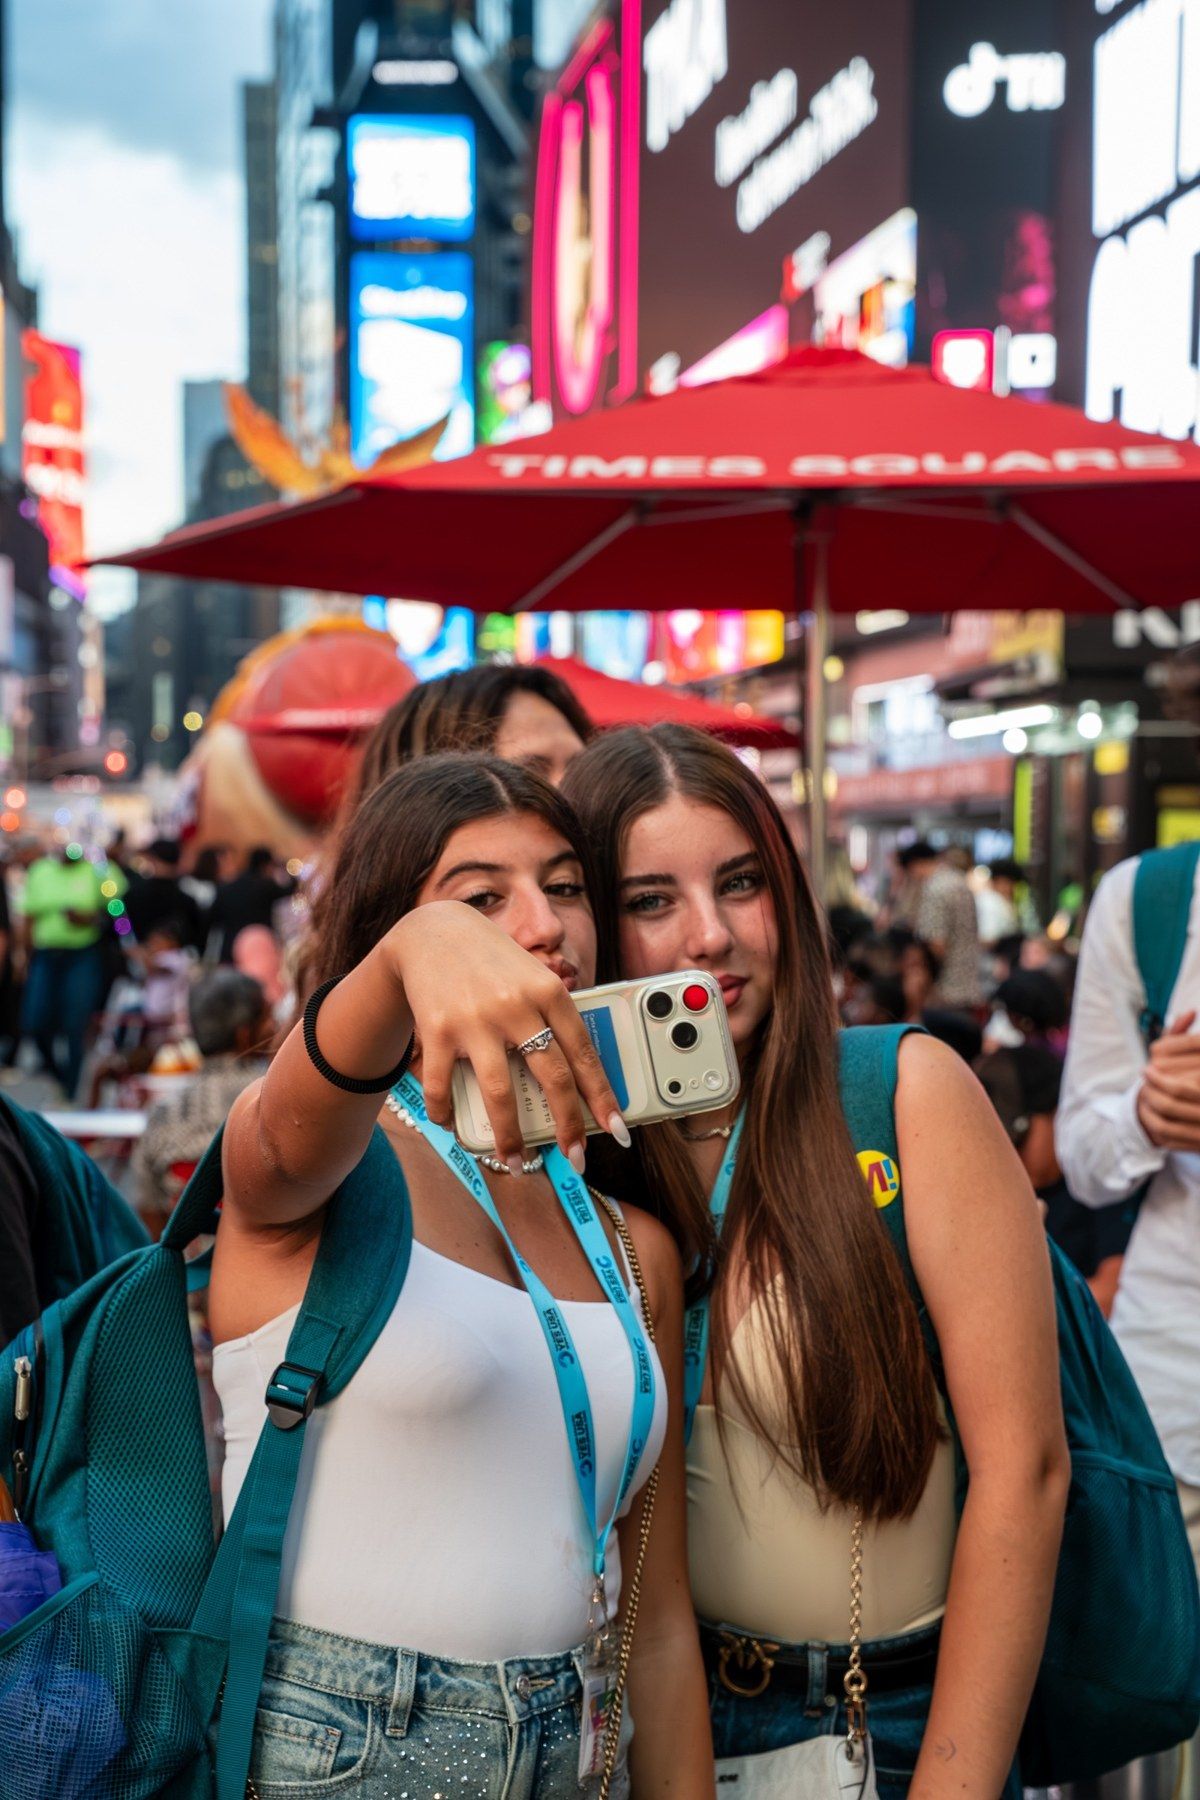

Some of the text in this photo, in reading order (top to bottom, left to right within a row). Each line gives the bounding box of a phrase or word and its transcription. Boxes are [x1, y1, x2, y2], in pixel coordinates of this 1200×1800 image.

[488, 446, 1184, 479] TIMES SQUARE
[545, 1308, 567, 1351] YES USA
[573, 1411, 589, 1459] YES USA
